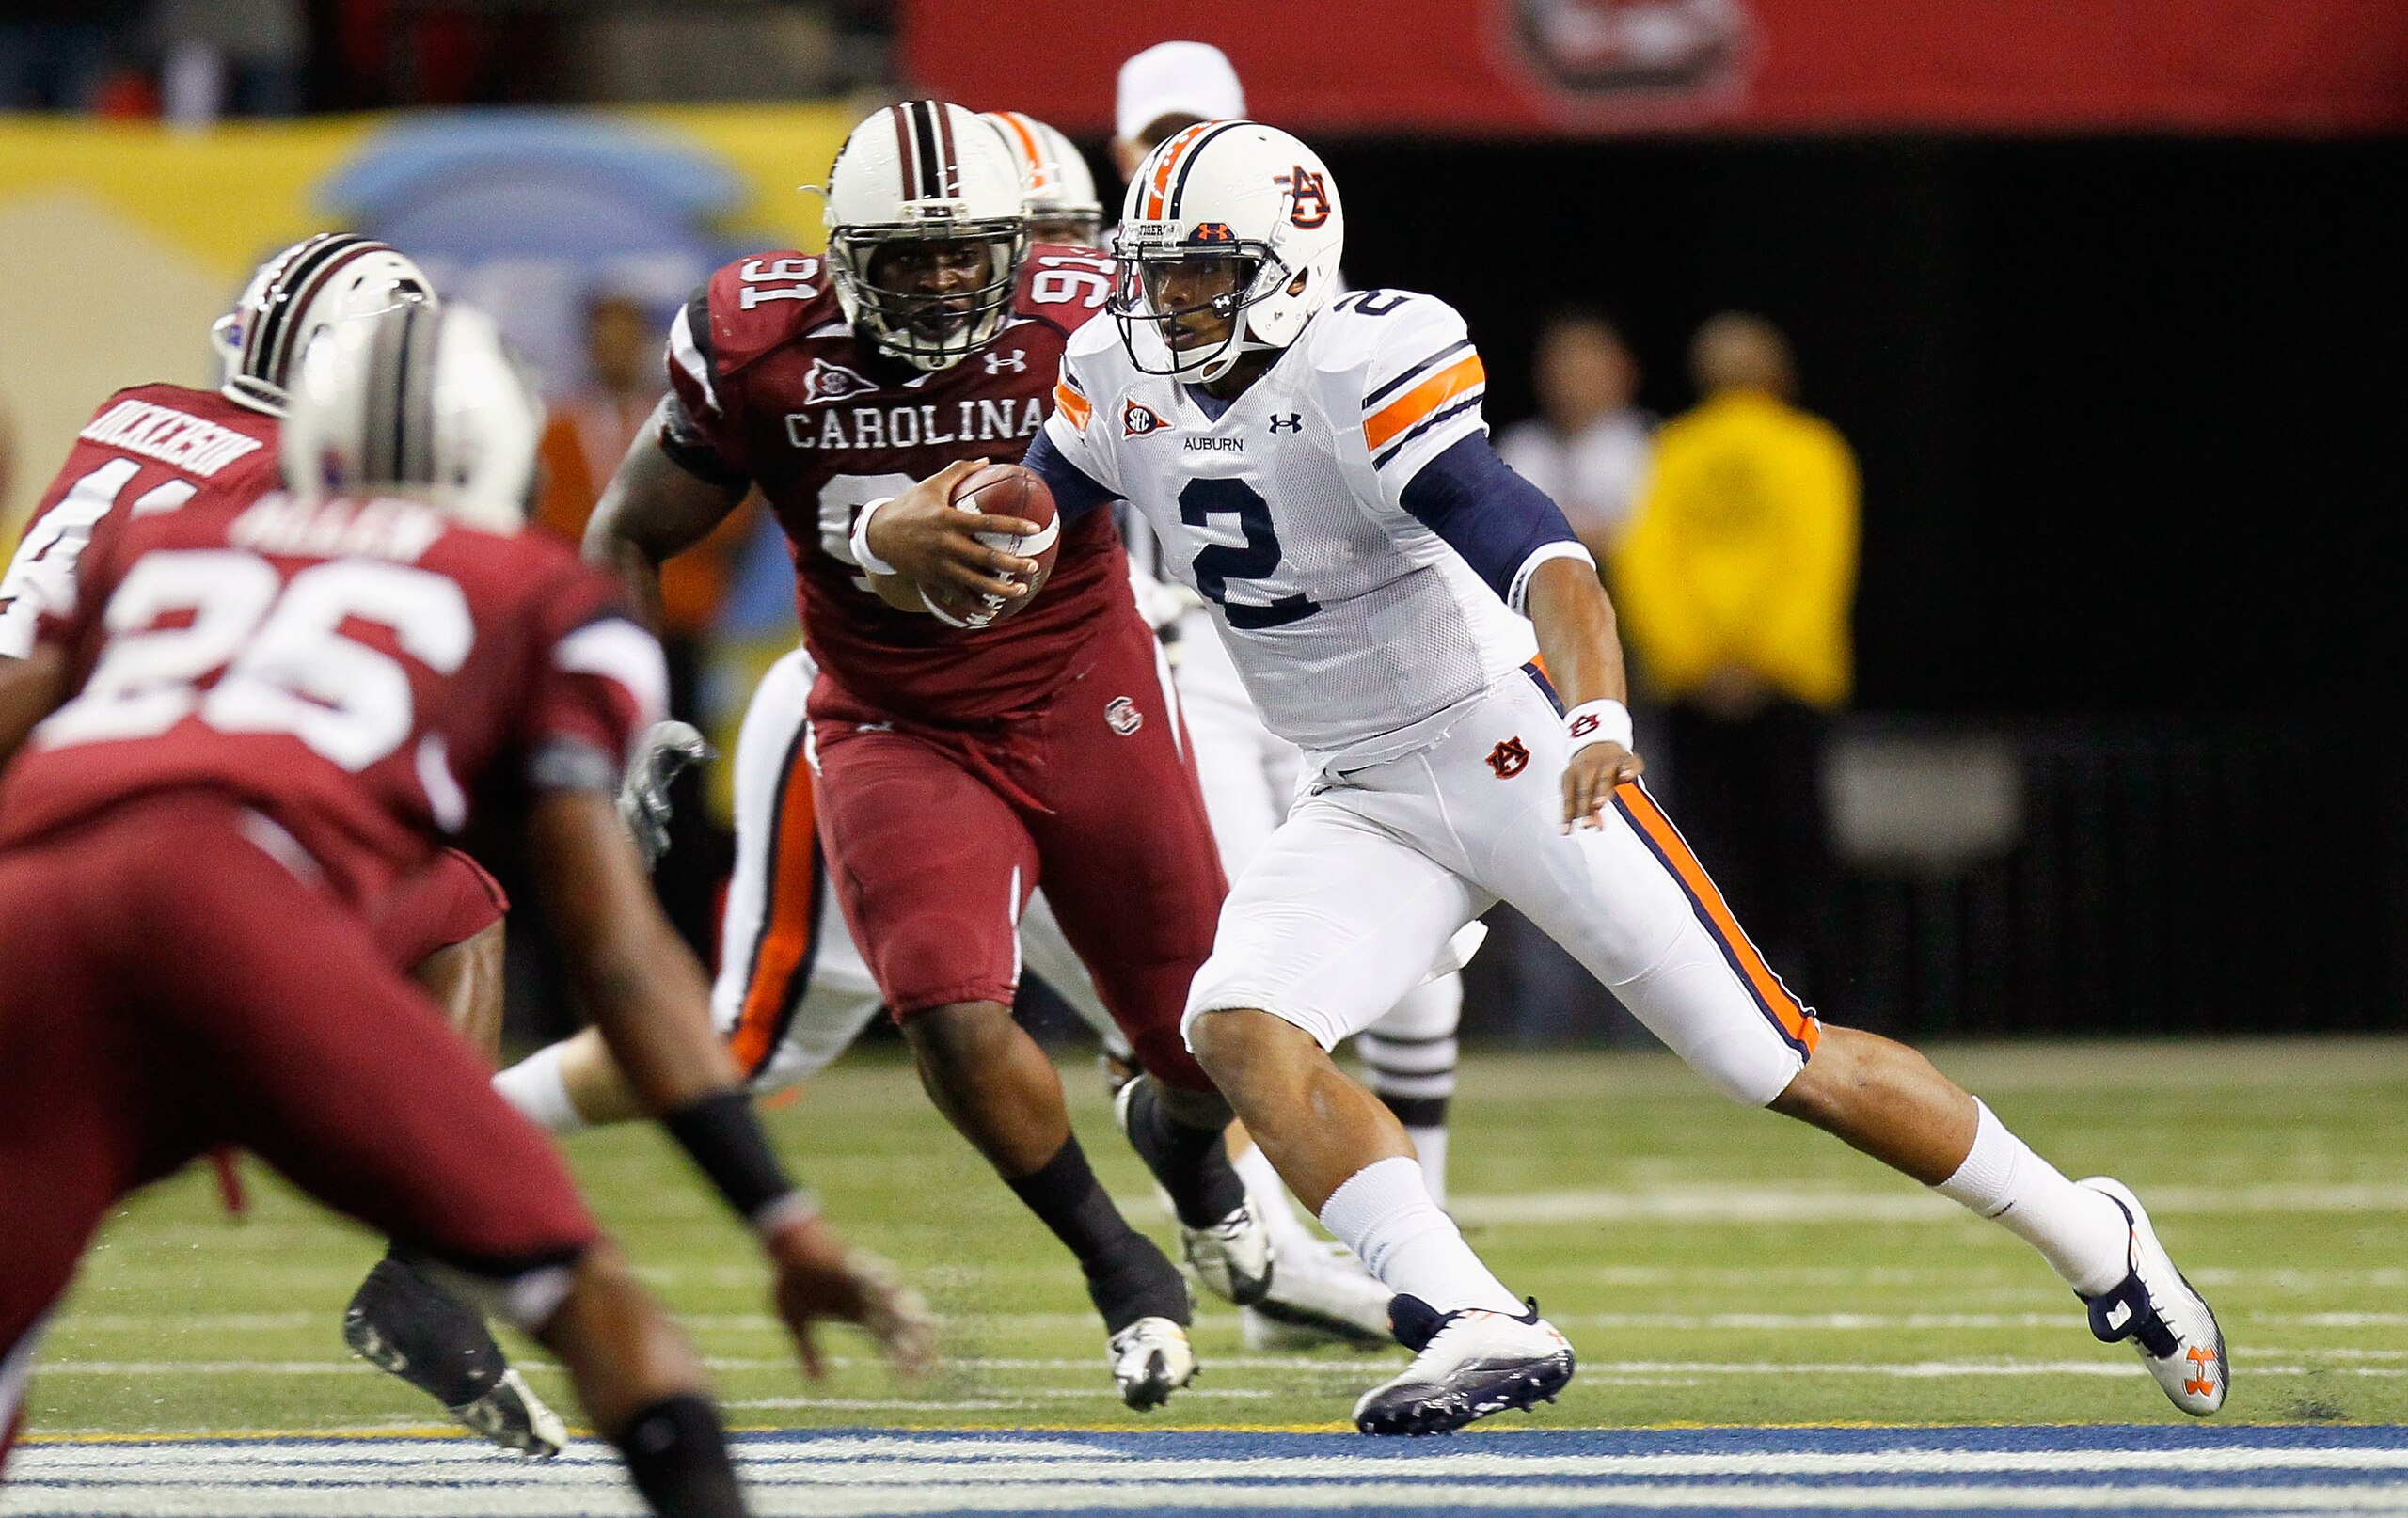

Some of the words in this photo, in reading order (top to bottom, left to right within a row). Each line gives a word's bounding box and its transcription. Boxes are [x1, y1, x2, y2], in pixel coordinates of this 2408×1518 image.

[739, 258, 818, 310] 91
[1031, 255, 1117, 309] 91
[1333, 289, 1414, 316] 2
[79, 399, 263, 478] DICKERSON
[784, 397, 1044, 450] CAROLINA
[1129, 408, 1149, 432] SEC
[1183, 437, 1243, 451] AUBURN
[1179, 478, 1322, 629] 2
[26, 547, 475, 773] 26
